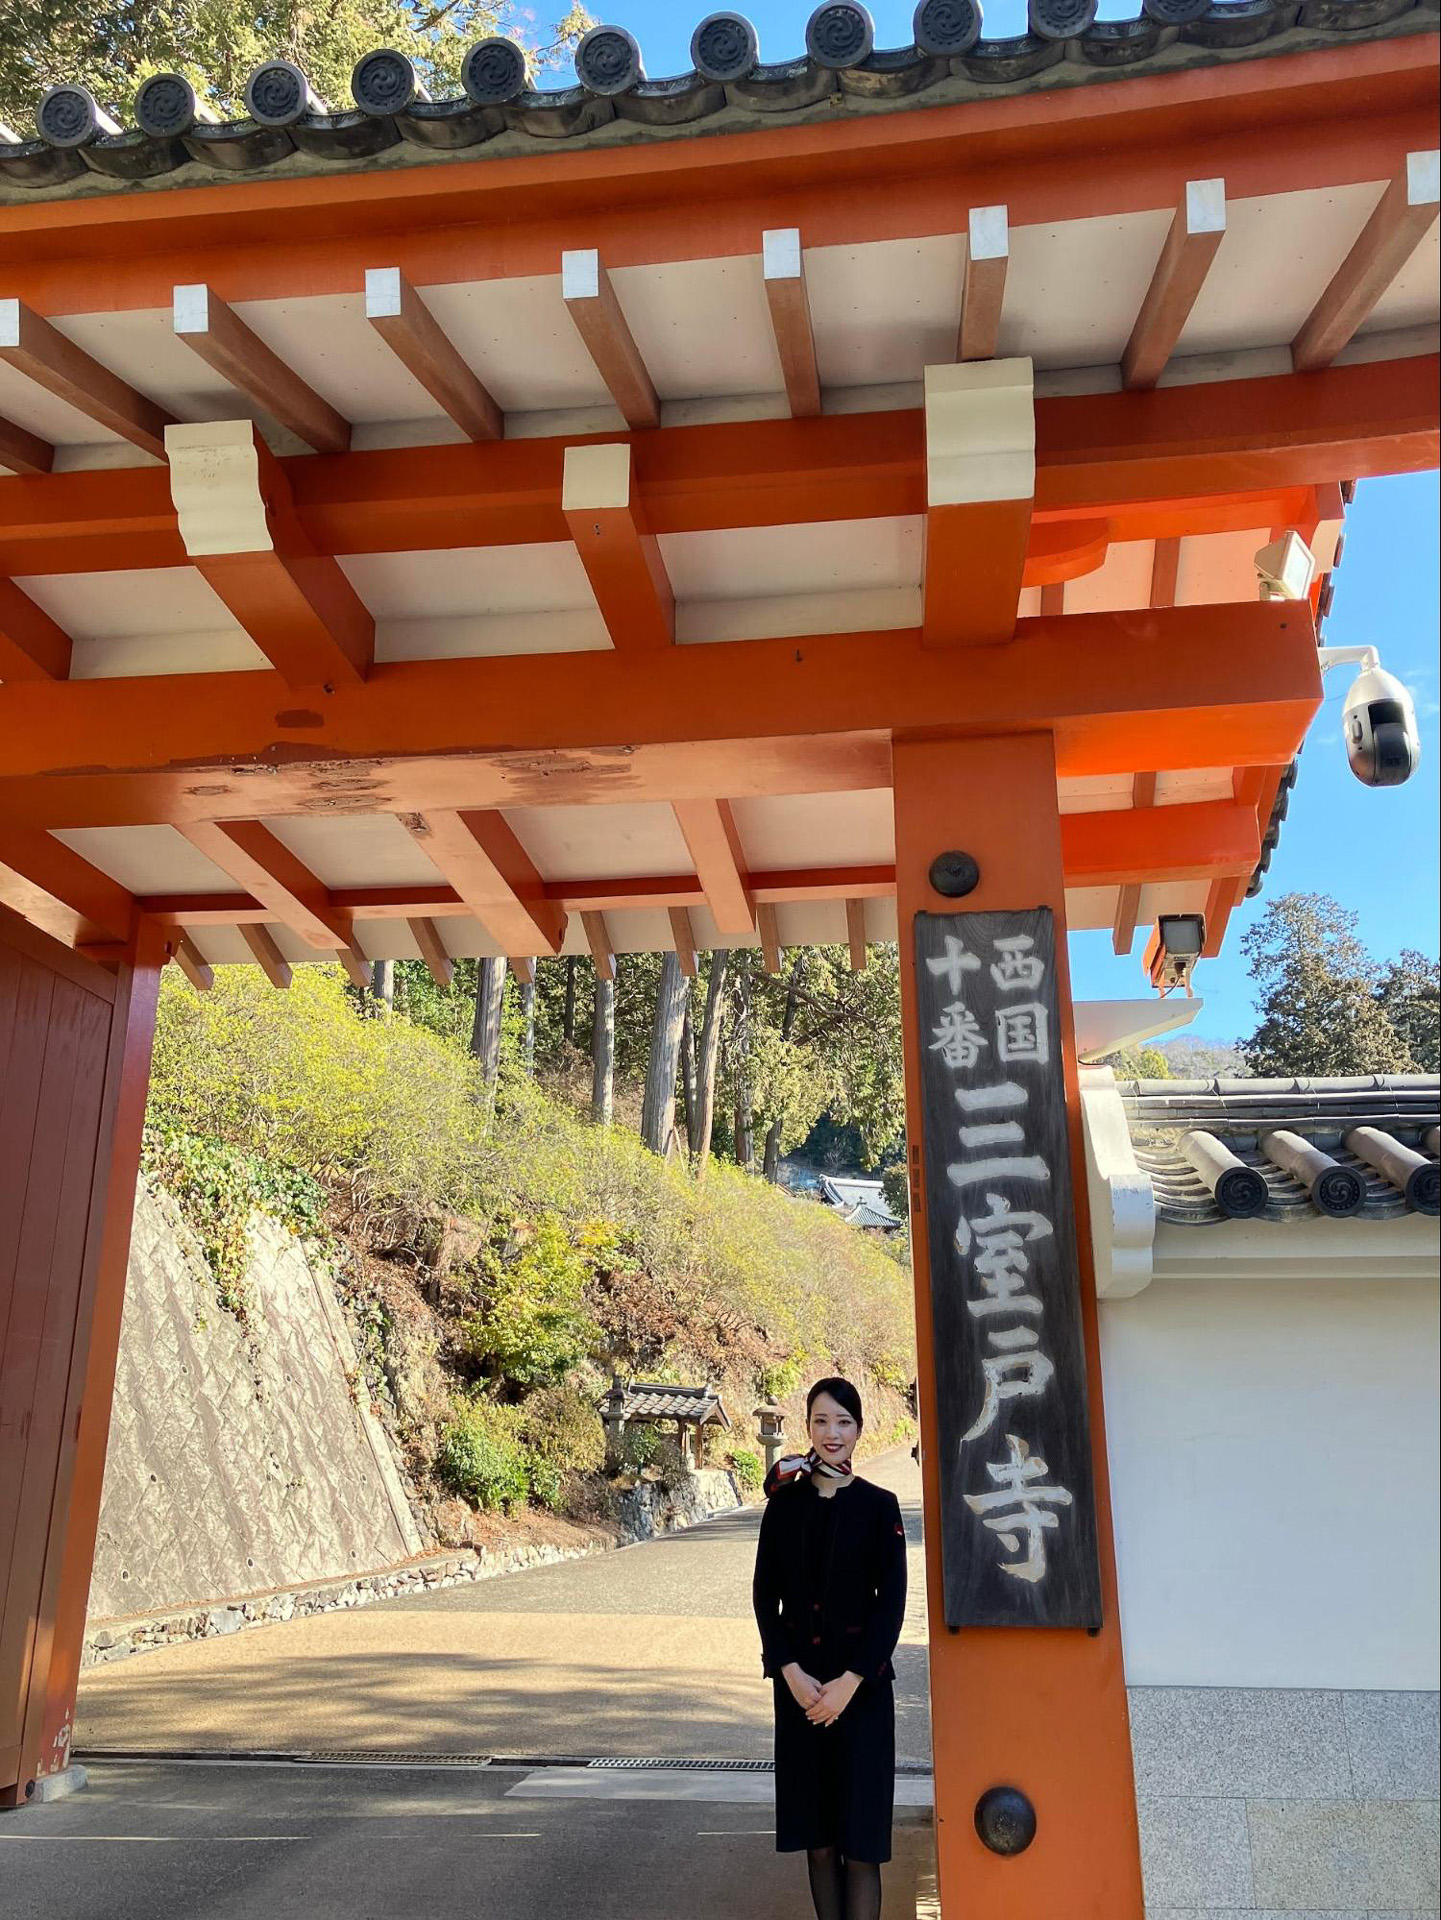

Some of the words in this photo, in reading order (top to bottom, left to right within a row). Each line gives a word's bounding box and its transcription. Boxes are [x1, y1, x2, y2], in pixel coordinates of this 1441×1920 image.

[925, 935, 989, 1069] 十番
[989, 933, 1050, 1067] 西国
[946, 1081, 1073, 1584] 三室戸寺
